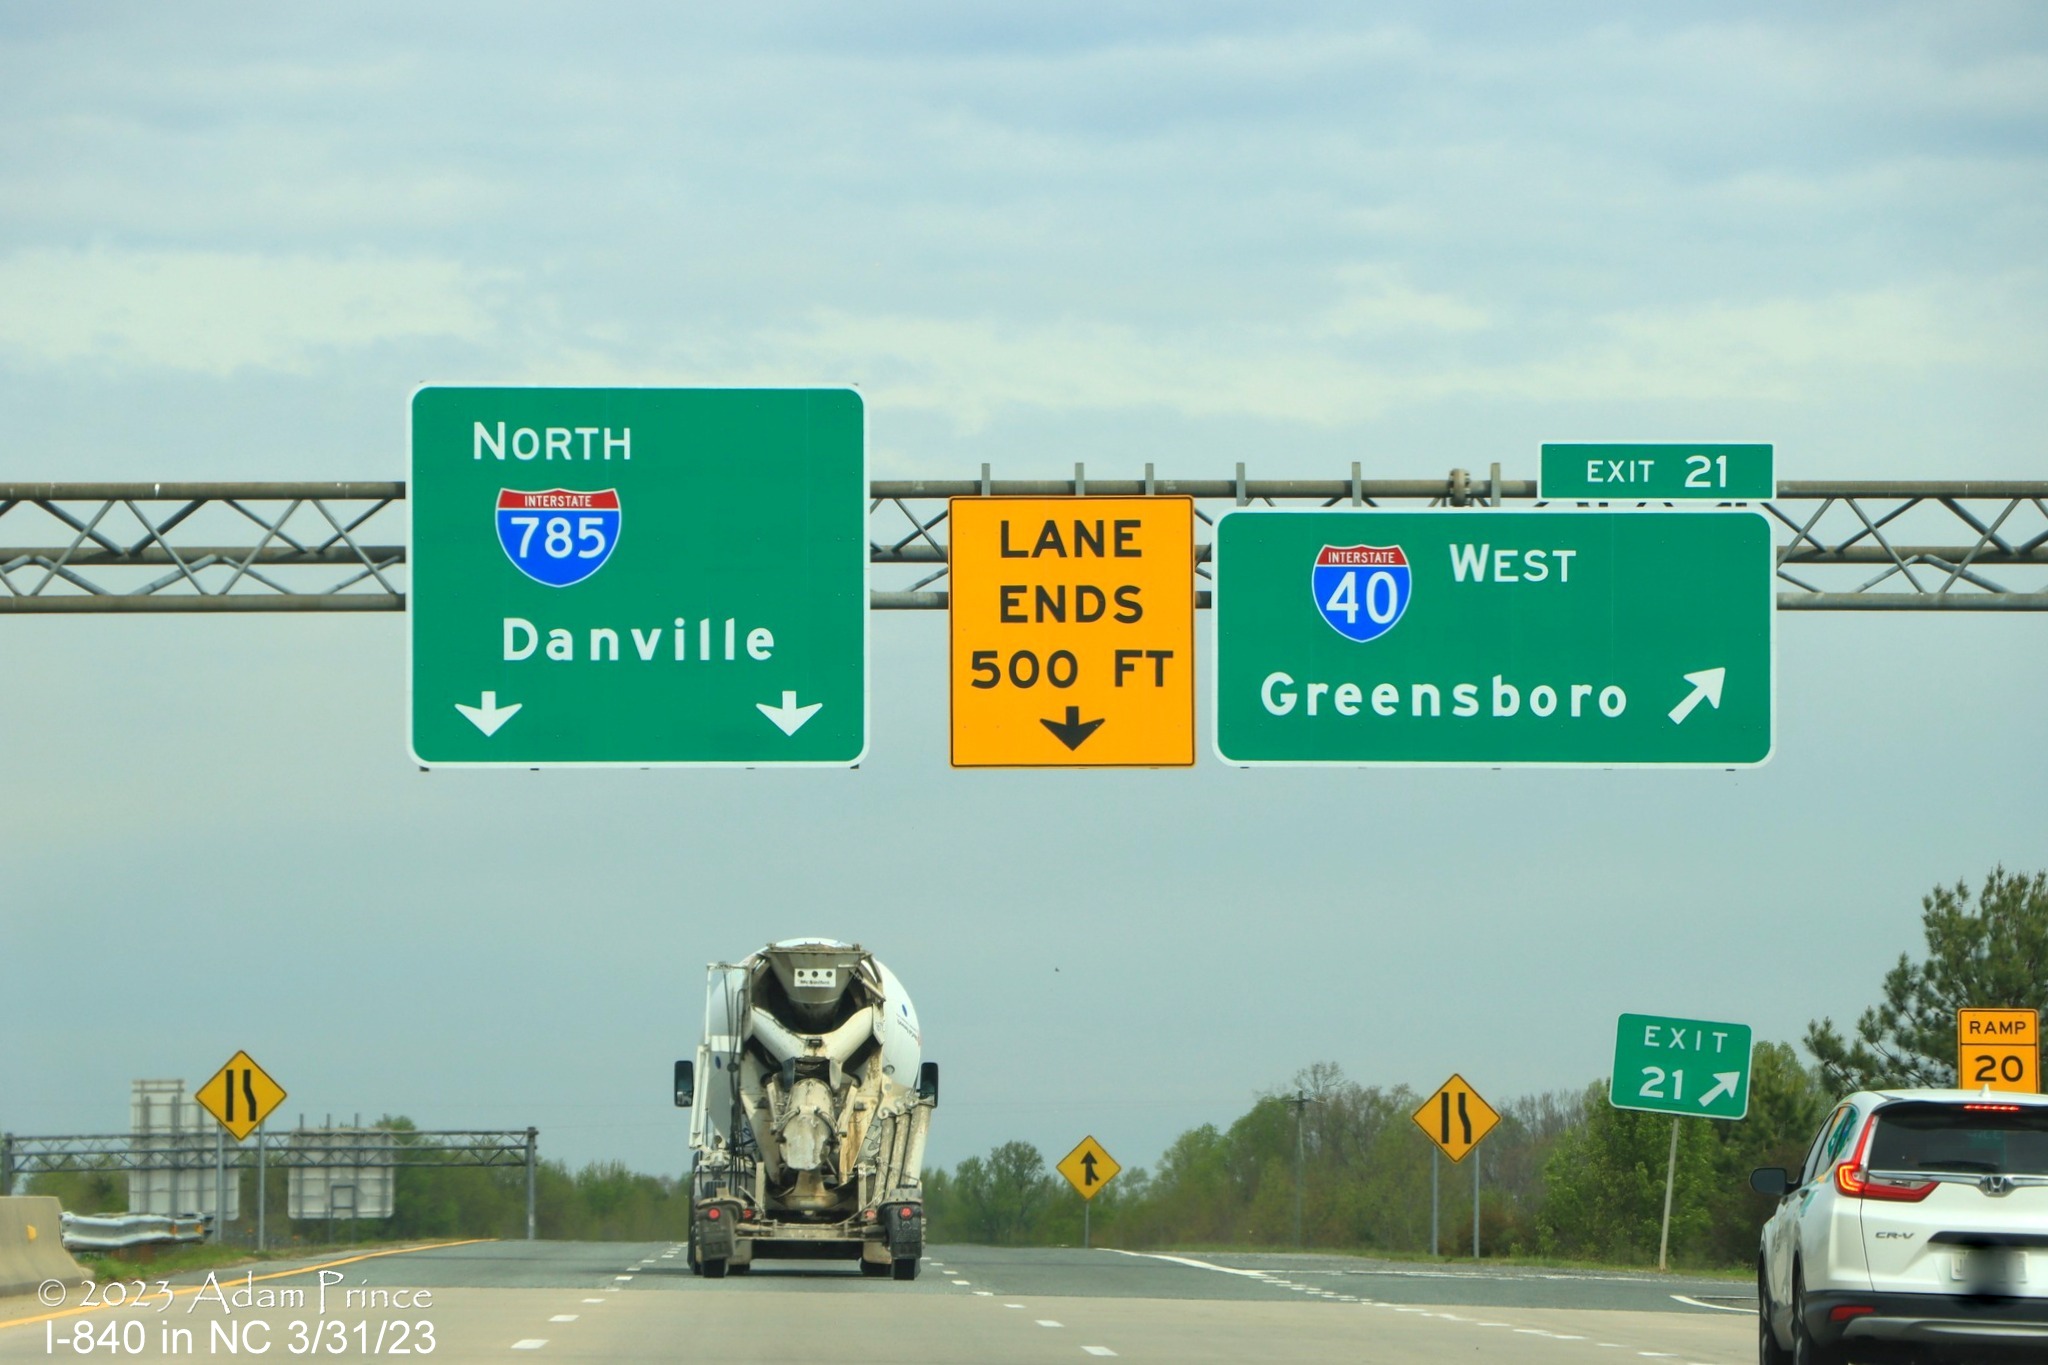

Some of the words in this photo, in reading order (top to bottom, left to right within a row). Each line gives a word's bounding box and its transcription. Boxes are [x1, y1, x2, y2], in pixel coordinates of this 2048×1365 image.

[474, 422, 630, 460] NORTH
[1586, 460, 1655, 484] EXIT
[1684, 455, 1728, 488] 21
[524, 494, 592, 507] INTERSTATE
[511, 517, 605, 559] 785
[1000, 519, 1142, 558] LANE
[1327, 550, 1396, 565] INTERSTATE
[1450, 543, 1577, 583] WEST
[1000, 585, 1143, 624] ENDS
[1325, 571, 1399, 625] 40
[503, 617, 775, 661] Danville
[971, 650, 1078, 689] 500
[1115, 649, 1174, 687] FT
[1261, 671, 1628, 718] Greensboro
[1644, 1025, 1728, 1054] EXIT
[1969, 1020, 2027, 1036] RAMP
[1639, 1066, 1683, 1100] 21
[1975, 1055, 2024, 1082] 20
[1875, 1231, 1915, 1239] CR-V
